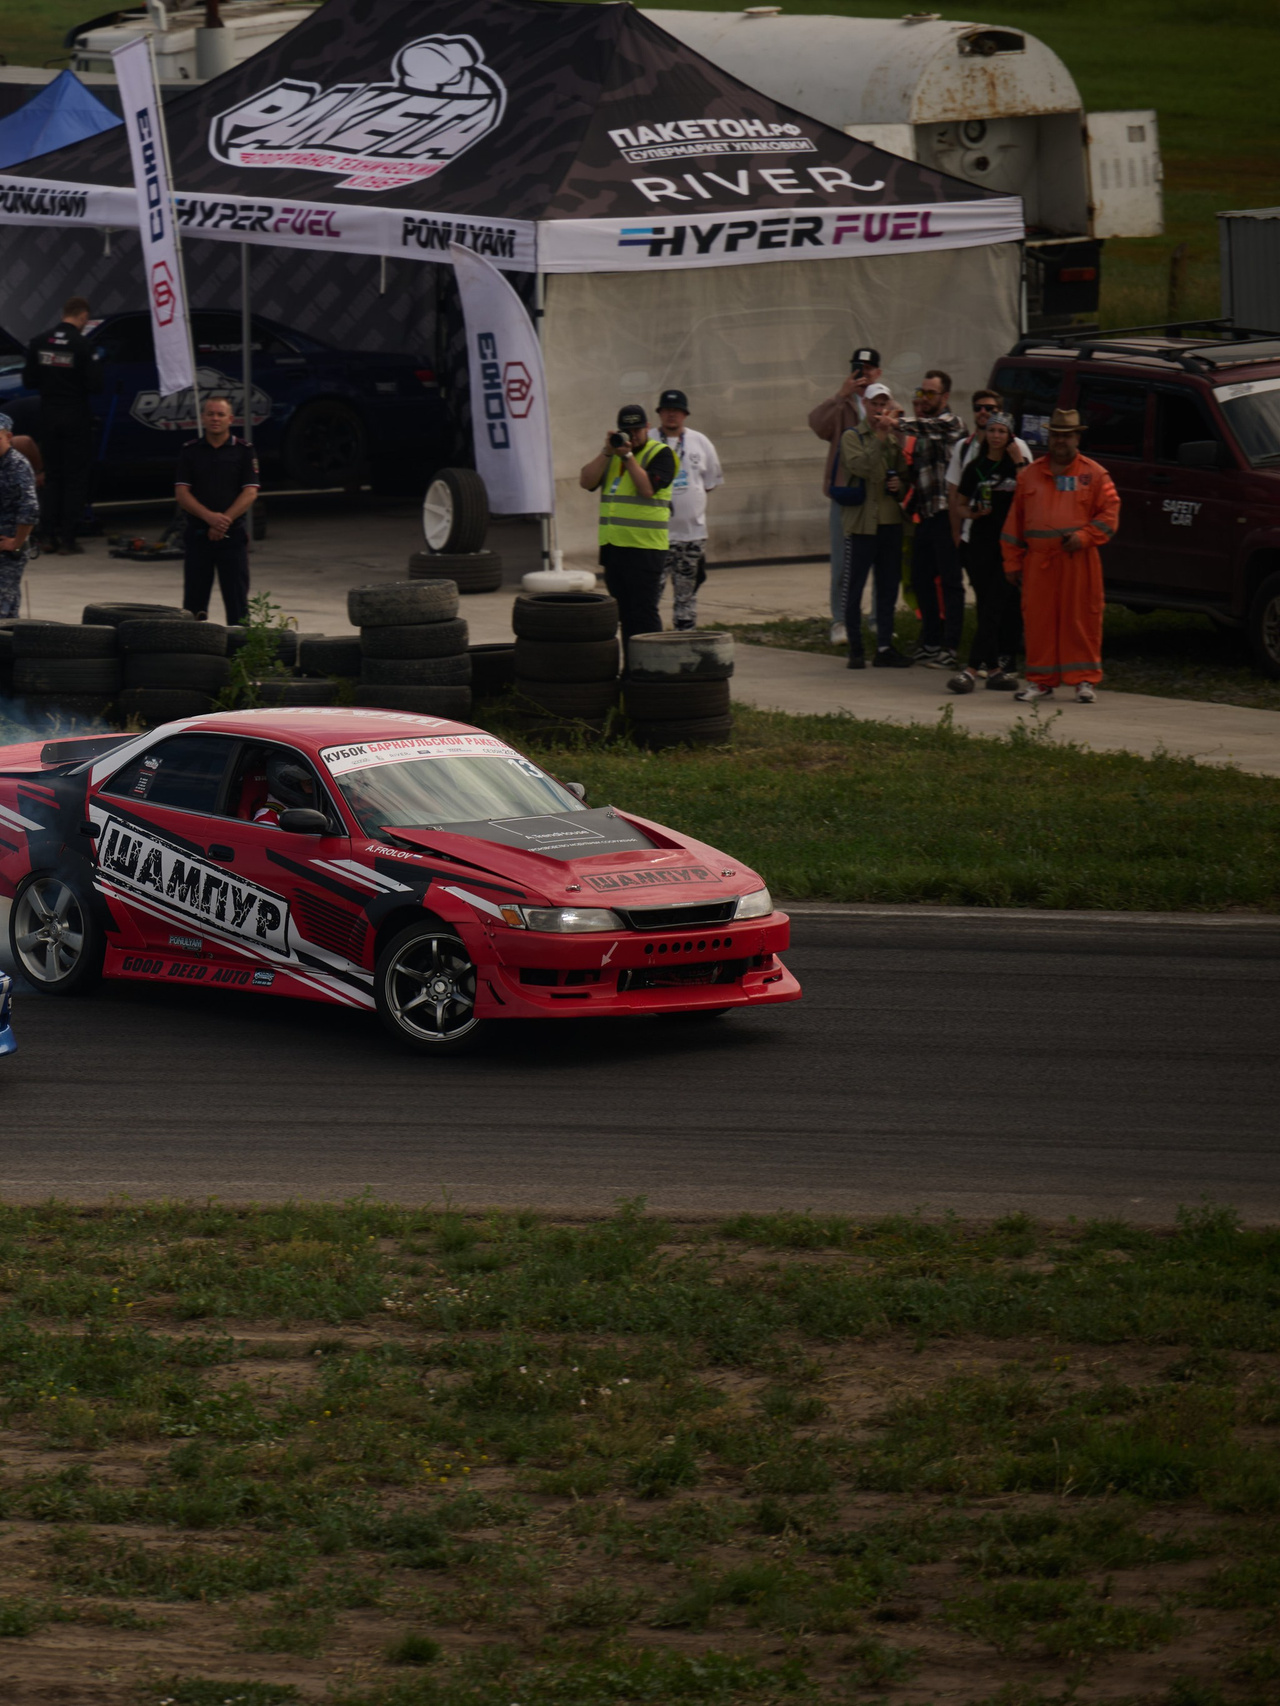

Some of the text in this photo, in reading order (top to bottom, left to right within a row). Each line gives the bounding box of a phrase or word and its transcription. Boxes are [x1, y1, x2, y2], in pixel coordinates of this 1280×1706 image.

[229, 83, 497, 159] РАКЕТА
[608, 118, 802, 148] ПАКЕТОН.РФ
[629, 138, 812, 161] СУПЕРМАРКЕТ УПАКОВКИ
[136, 107, 165, 243] СОЮЗ
[631, 166, 885, 202] RIVER
[177, 199, 341, 238] HYPER FUEL
[649, 211, 944, 256] HYPER FUEL
[477, 332, 510, 449] СОЮЗ
[1162, 499, 1202, 514] SAFETY
[1171, 513, 1193, 526] CAR
[323, 745, 367, 763] КУБОК
[367, 736, 463, 753] БАРНАУЛЬСКОЙ
[508, 758, 544, 779] 13
[365, 845, 413, 859] A.FROLOV
[103, 829, 281, 939] ШАМПУР
[591, 868, 709, 889] ШАМПУР
